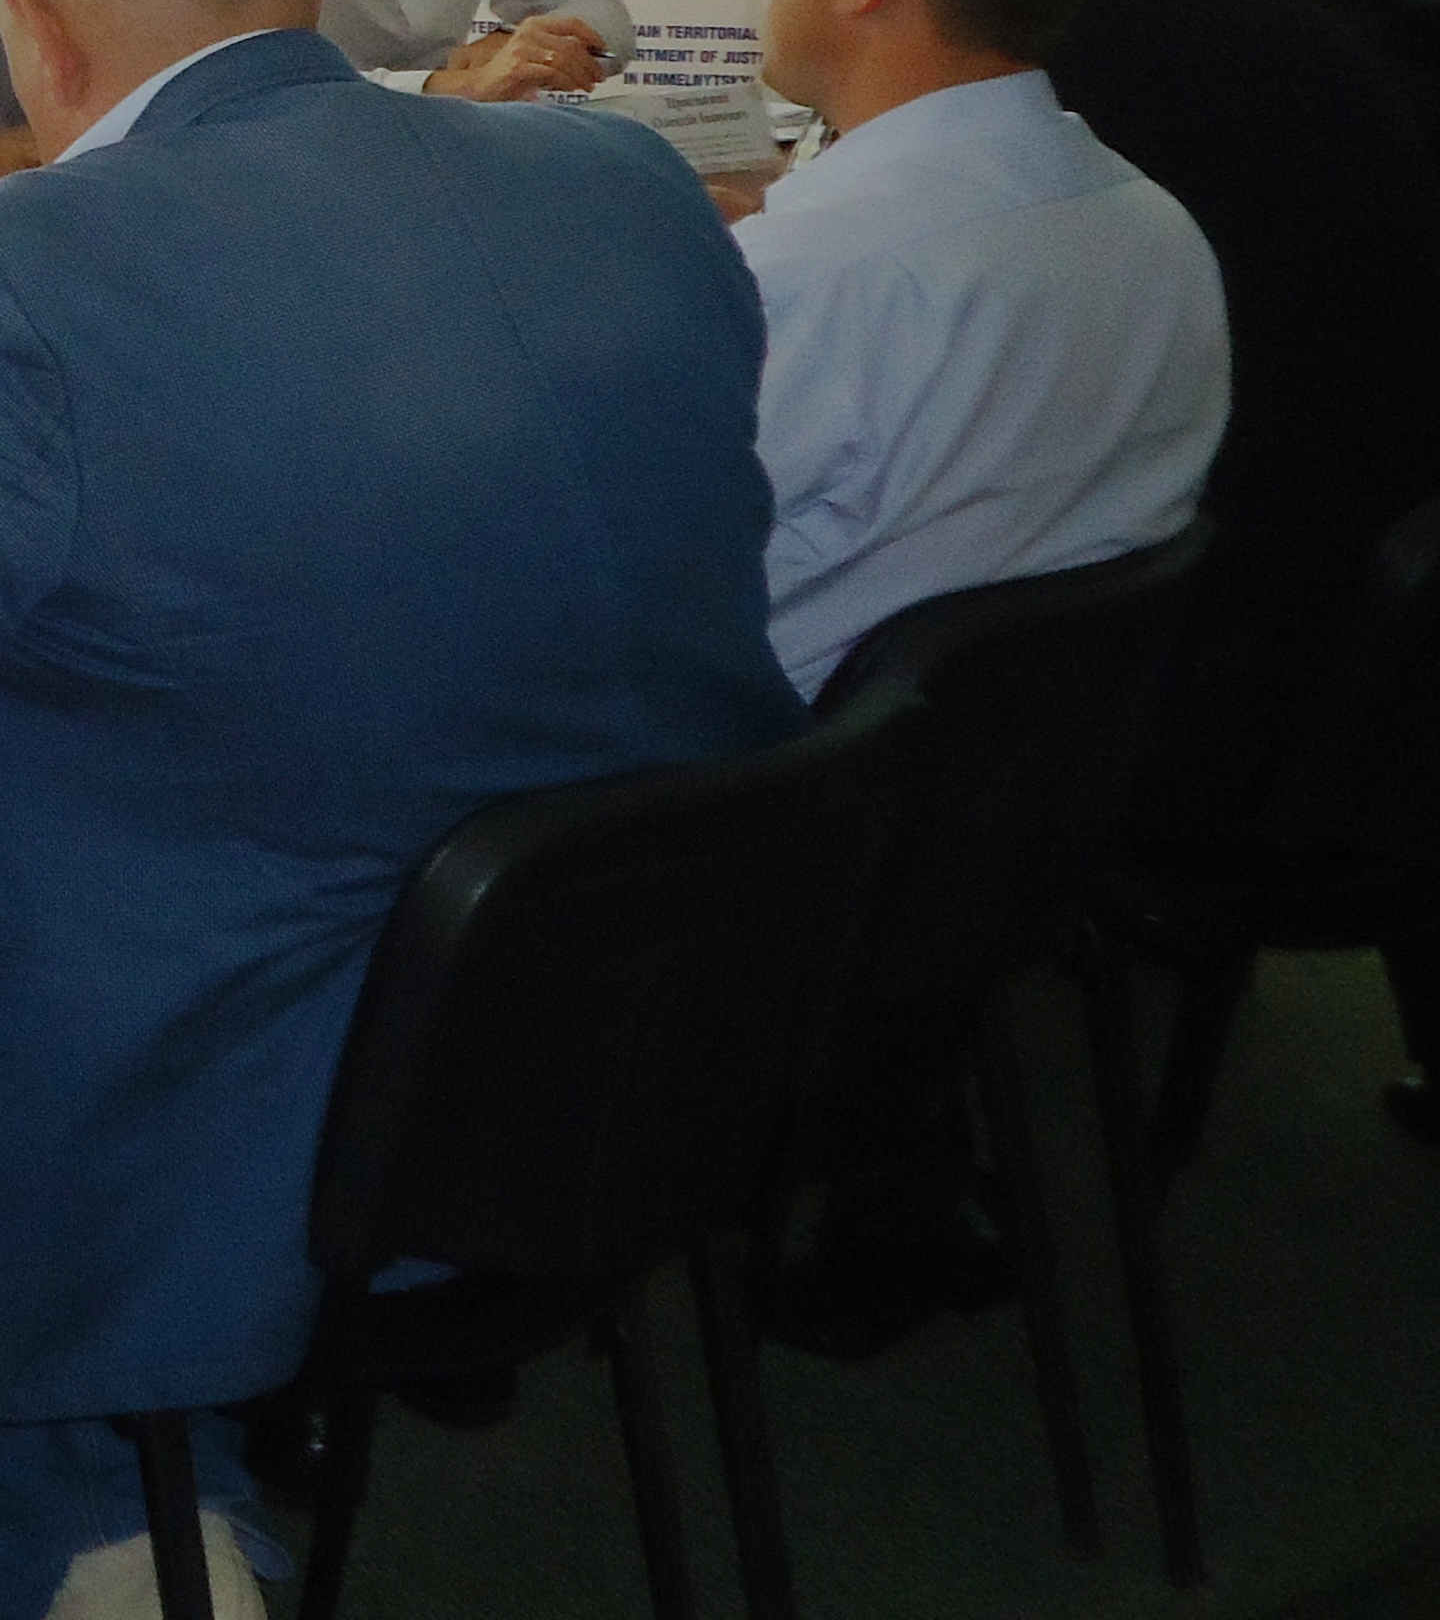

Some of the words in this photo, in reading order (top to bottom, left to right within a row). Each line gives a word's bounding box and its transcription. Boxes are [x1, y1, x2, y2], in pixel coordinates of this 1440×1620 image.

[633, 25, 661, 38] AIN
[666, 26, 758, 40] TERRITORIAL
[701, 50, 718, 63] OF
[624, 73, 637, 84] IN
